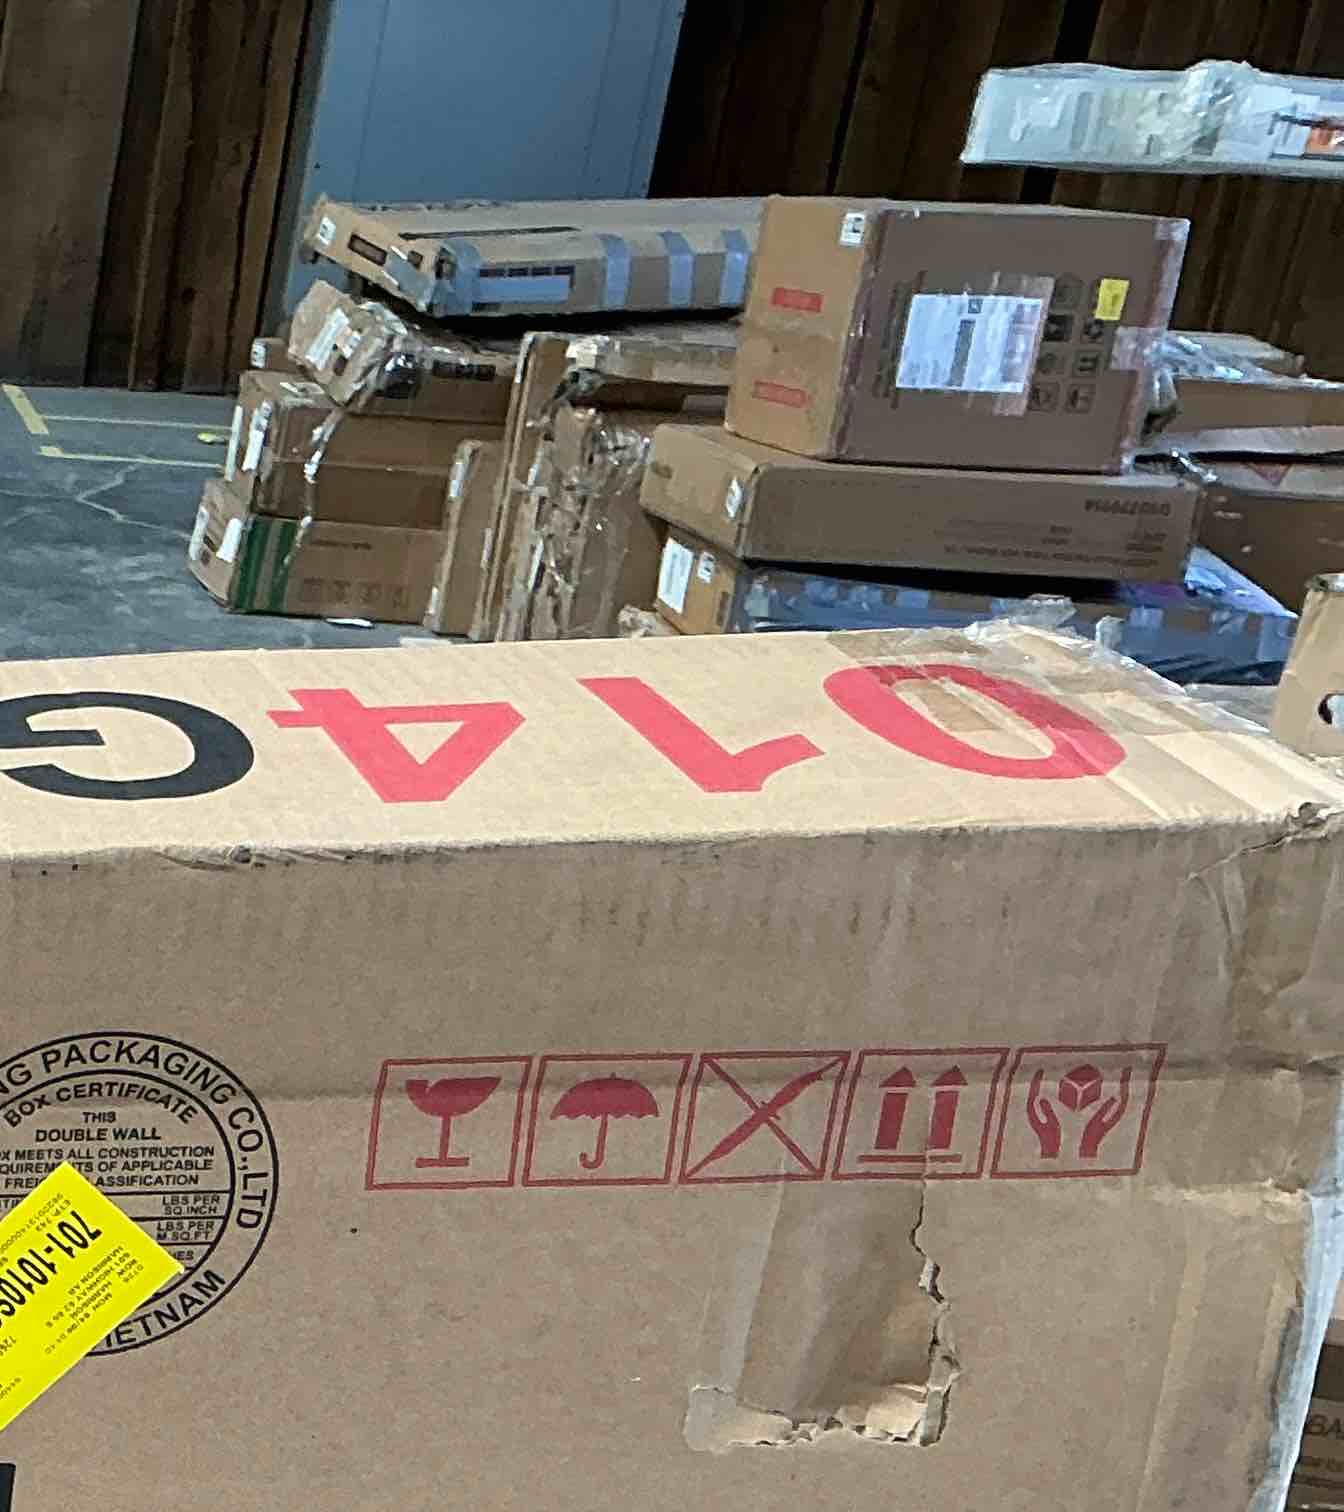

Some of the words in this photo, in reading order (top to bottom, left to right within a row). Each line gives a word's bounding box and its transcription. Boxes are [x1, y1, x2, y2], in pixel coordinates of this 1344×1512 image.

[40, 1039, 238, 1106] PACKAGING
[3, 1094, 49, 1128] BOX
[56, 1081, 199, 1124] CERTIFICATE
[82, 1111, 116, 1124] THIS
[35, 1129, 107, 1142] DOUBLE
[113, 1128, 161, 1140] WALL
[14, 1149, 63, 1160] MEETS
[66, 1148, 94, 1159] ALL
[98, 1147, 214, 1159] CONSTRUCTION
[98, 1161, 115, 1172] OF
[117, 1160, 213, 1171] APPLICABLE
[162, 1195, 189, 1206] LBS
[193, 1194, 221, 1206] PER
[156, 1221, 185, 1232] LBS
[187, 1220, 215, 1231] PER
[104, 1268, 226, 1348] IETNAM
